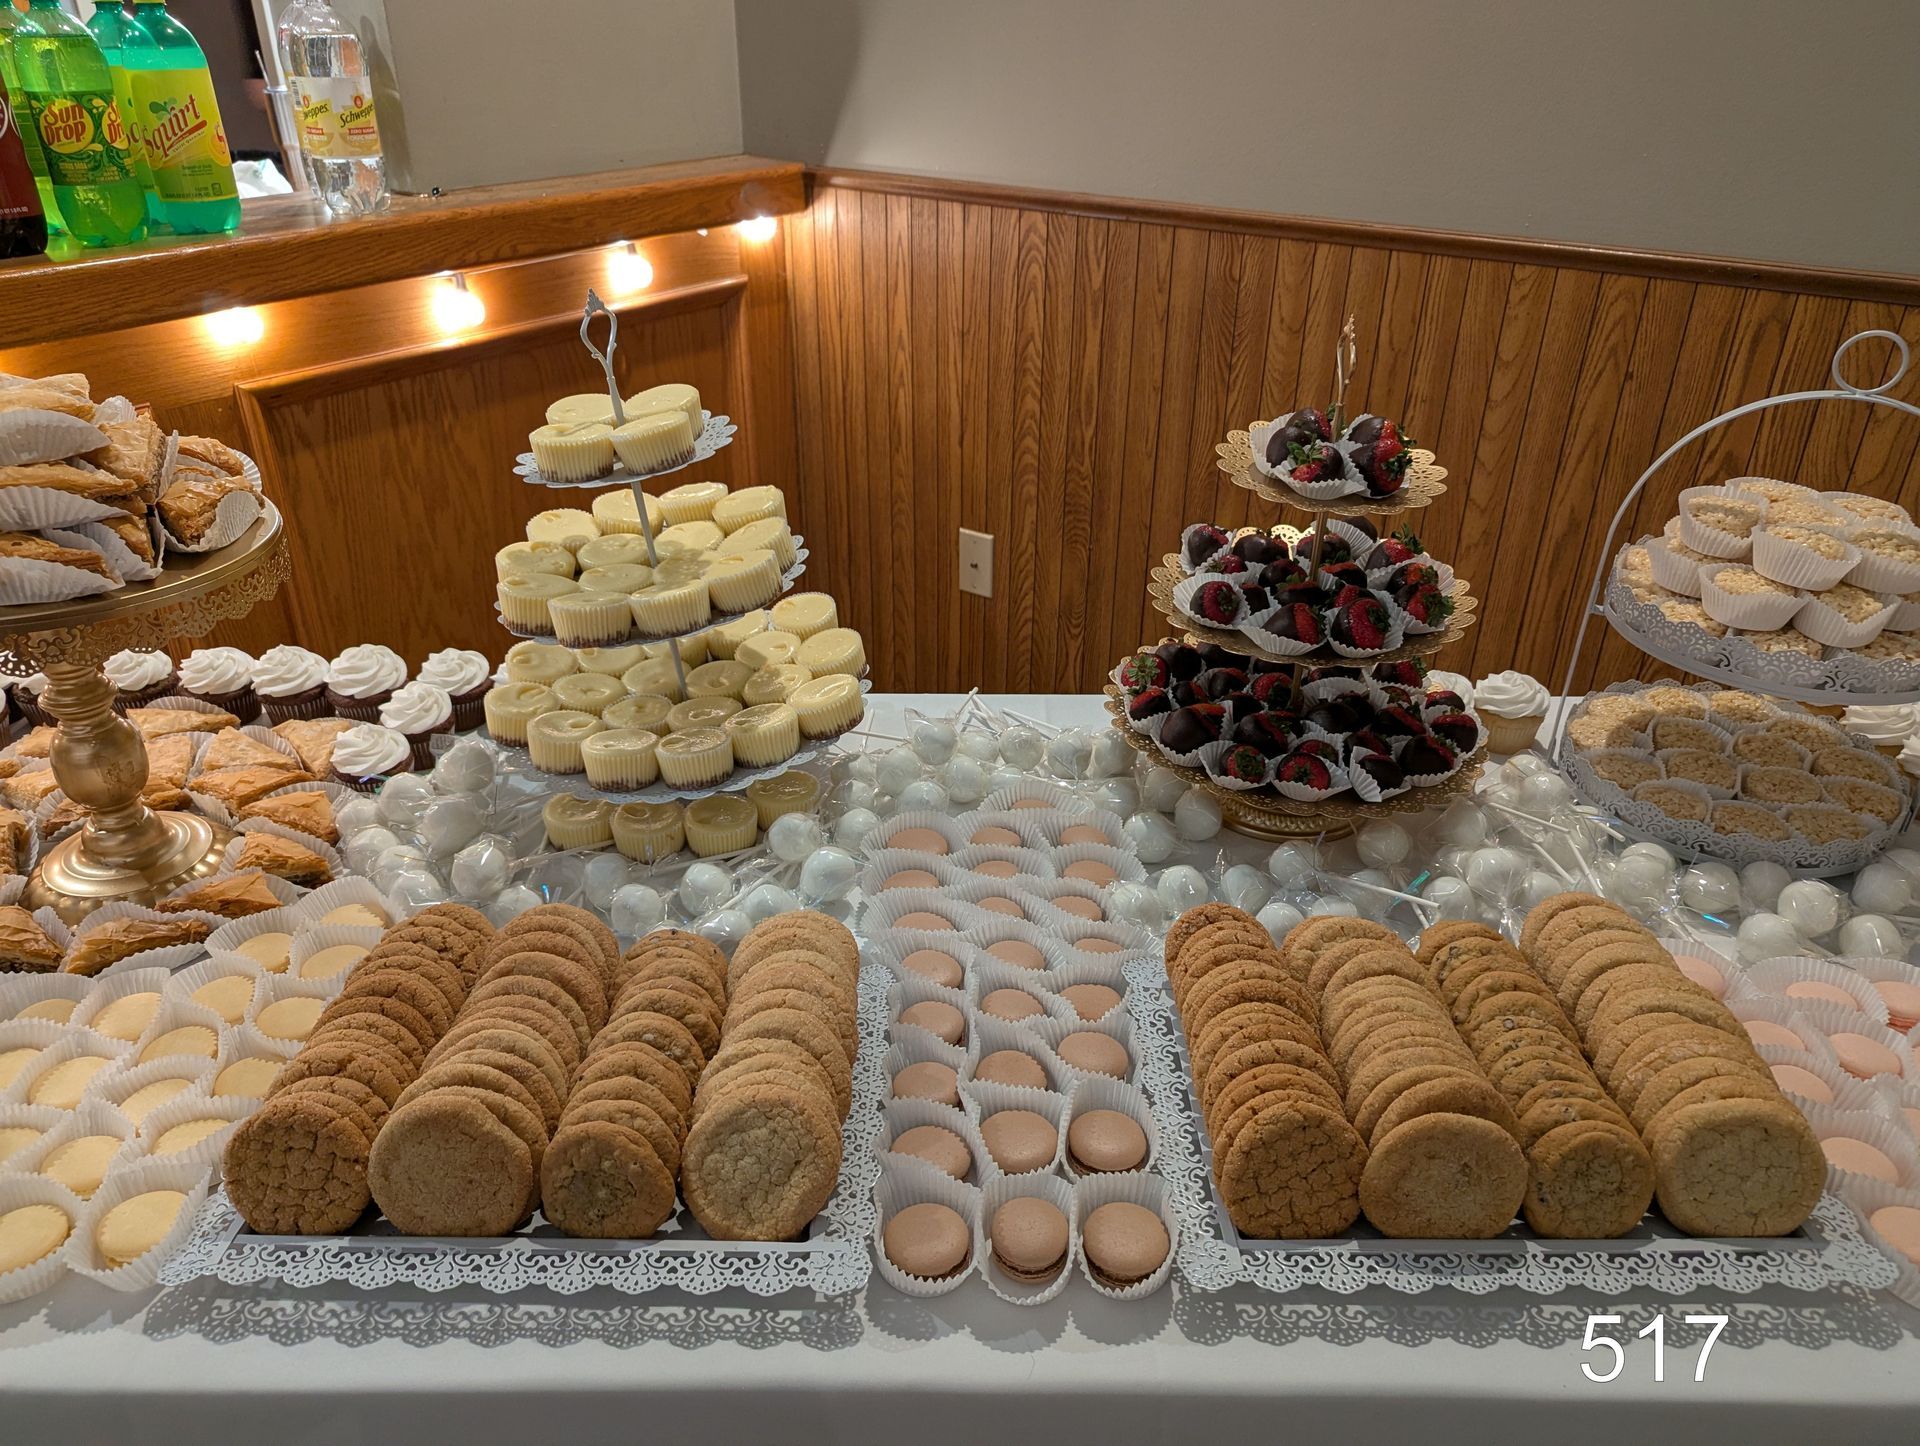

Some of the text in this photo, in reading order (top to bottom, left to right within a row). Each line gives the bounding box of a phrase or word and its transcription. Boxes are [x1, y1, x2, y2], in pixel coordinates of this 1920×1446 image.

[43, 102, 84, 126] Sun
[304, 103, 329, 120] weppes
[339, 103, 374, 128] Schweppe
[44, 121, 86, 146] Drop
[142, 93, 200, 158] Squirt
